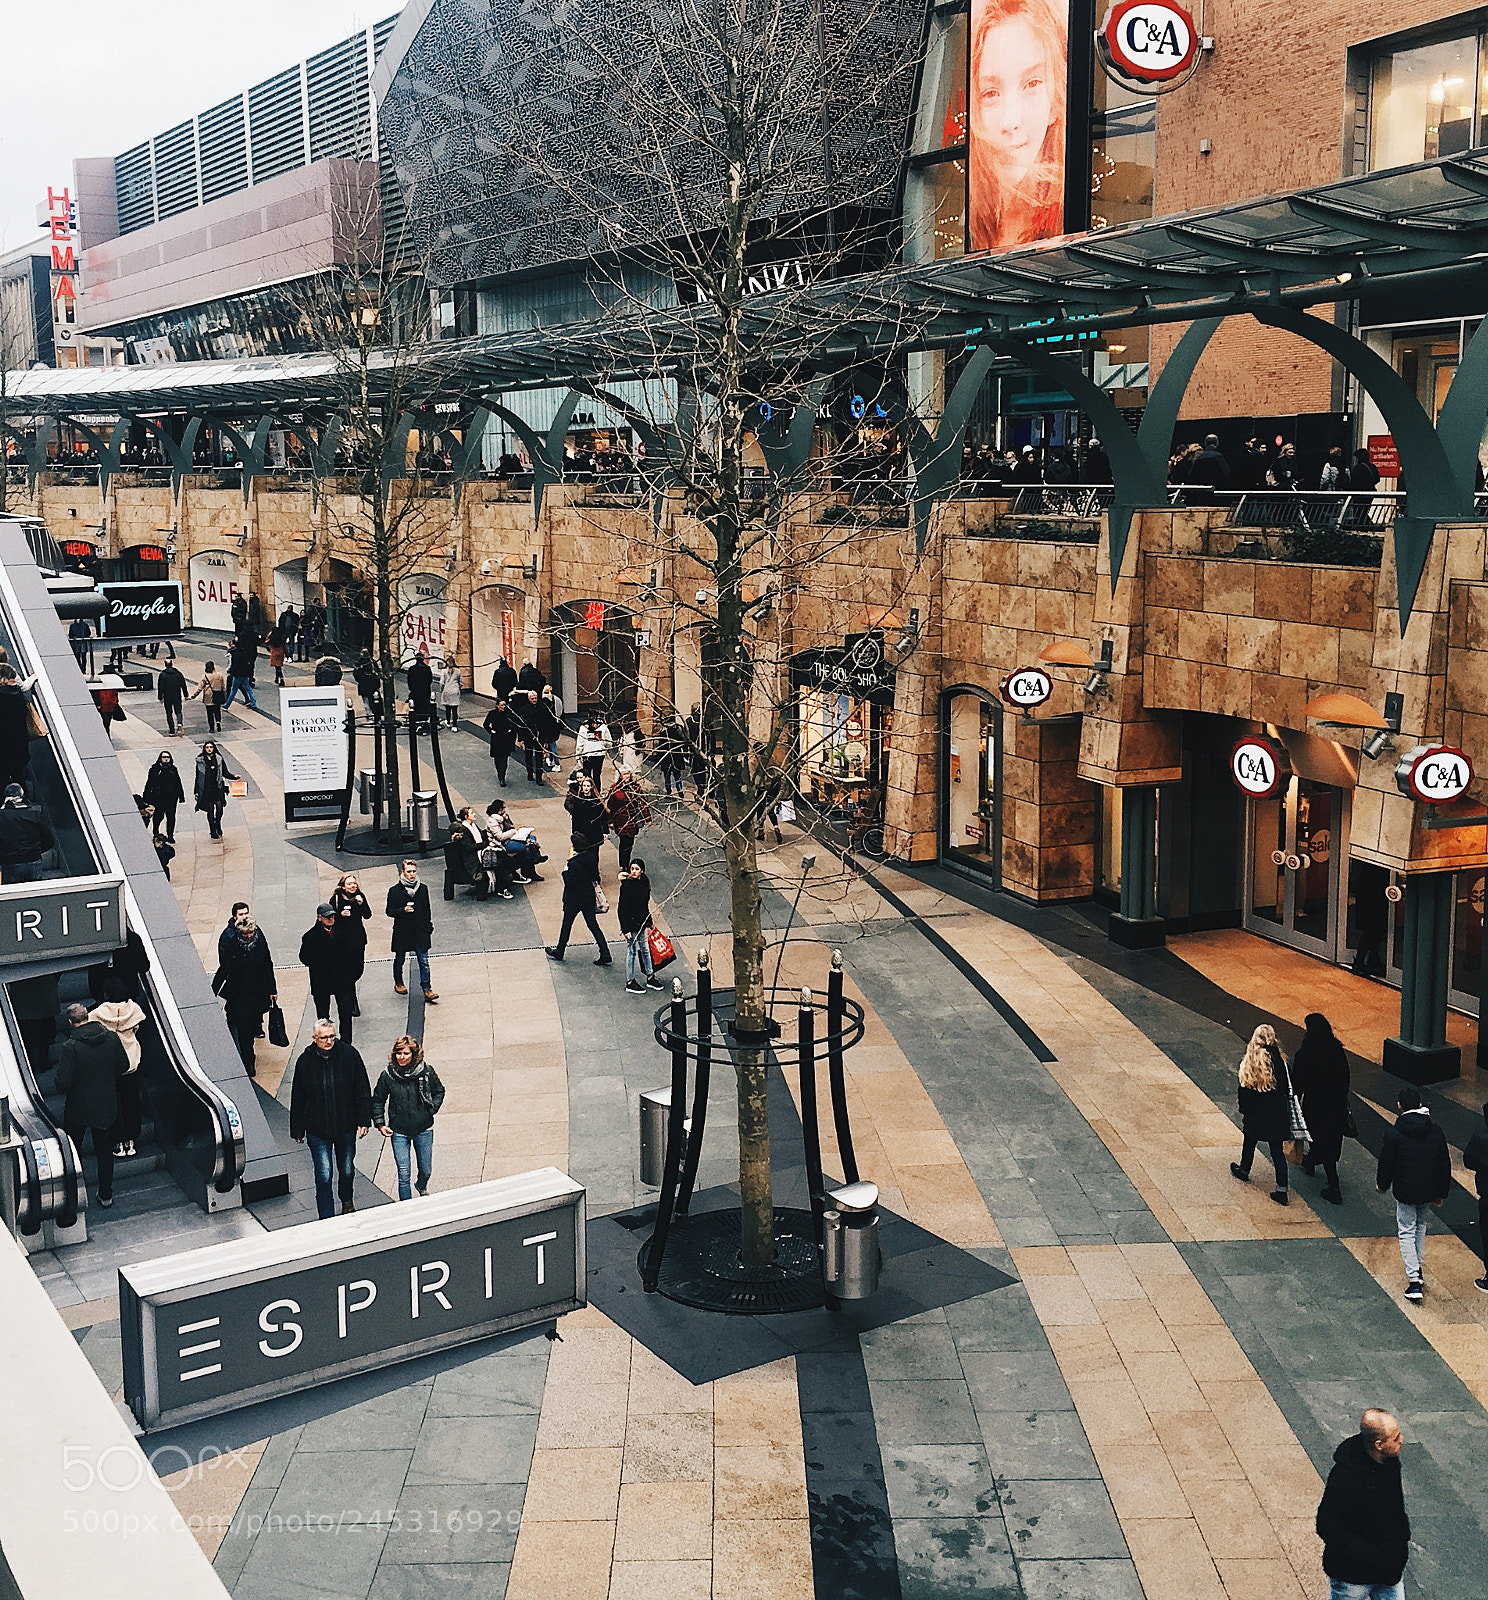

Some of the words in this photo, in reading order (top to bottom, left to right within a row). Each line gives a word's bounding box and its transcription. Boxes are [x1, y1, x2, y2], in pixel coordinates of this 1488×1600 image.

[1126, 16, 1182, 56] C&A
[47, 186, 76, 299] HEMA
[66, 541, 92, 555] HEMA
[140, 547, 164, 561] HEMA
[208, 558, 226, 567] ZARA
[197, 579, 238, 603] SALE
[109, 597, 176, 620] Douglas
[406, 612, 446, 645] SALE
[1014, 678, 1045, 696] C&A
[1237, 753, 1270, 784] C&A
[1422, 763, 1463, 788] C&A
[1309, 834, 1330, 853] sal
[178, 1231, 558, 1382] ESPRIT
